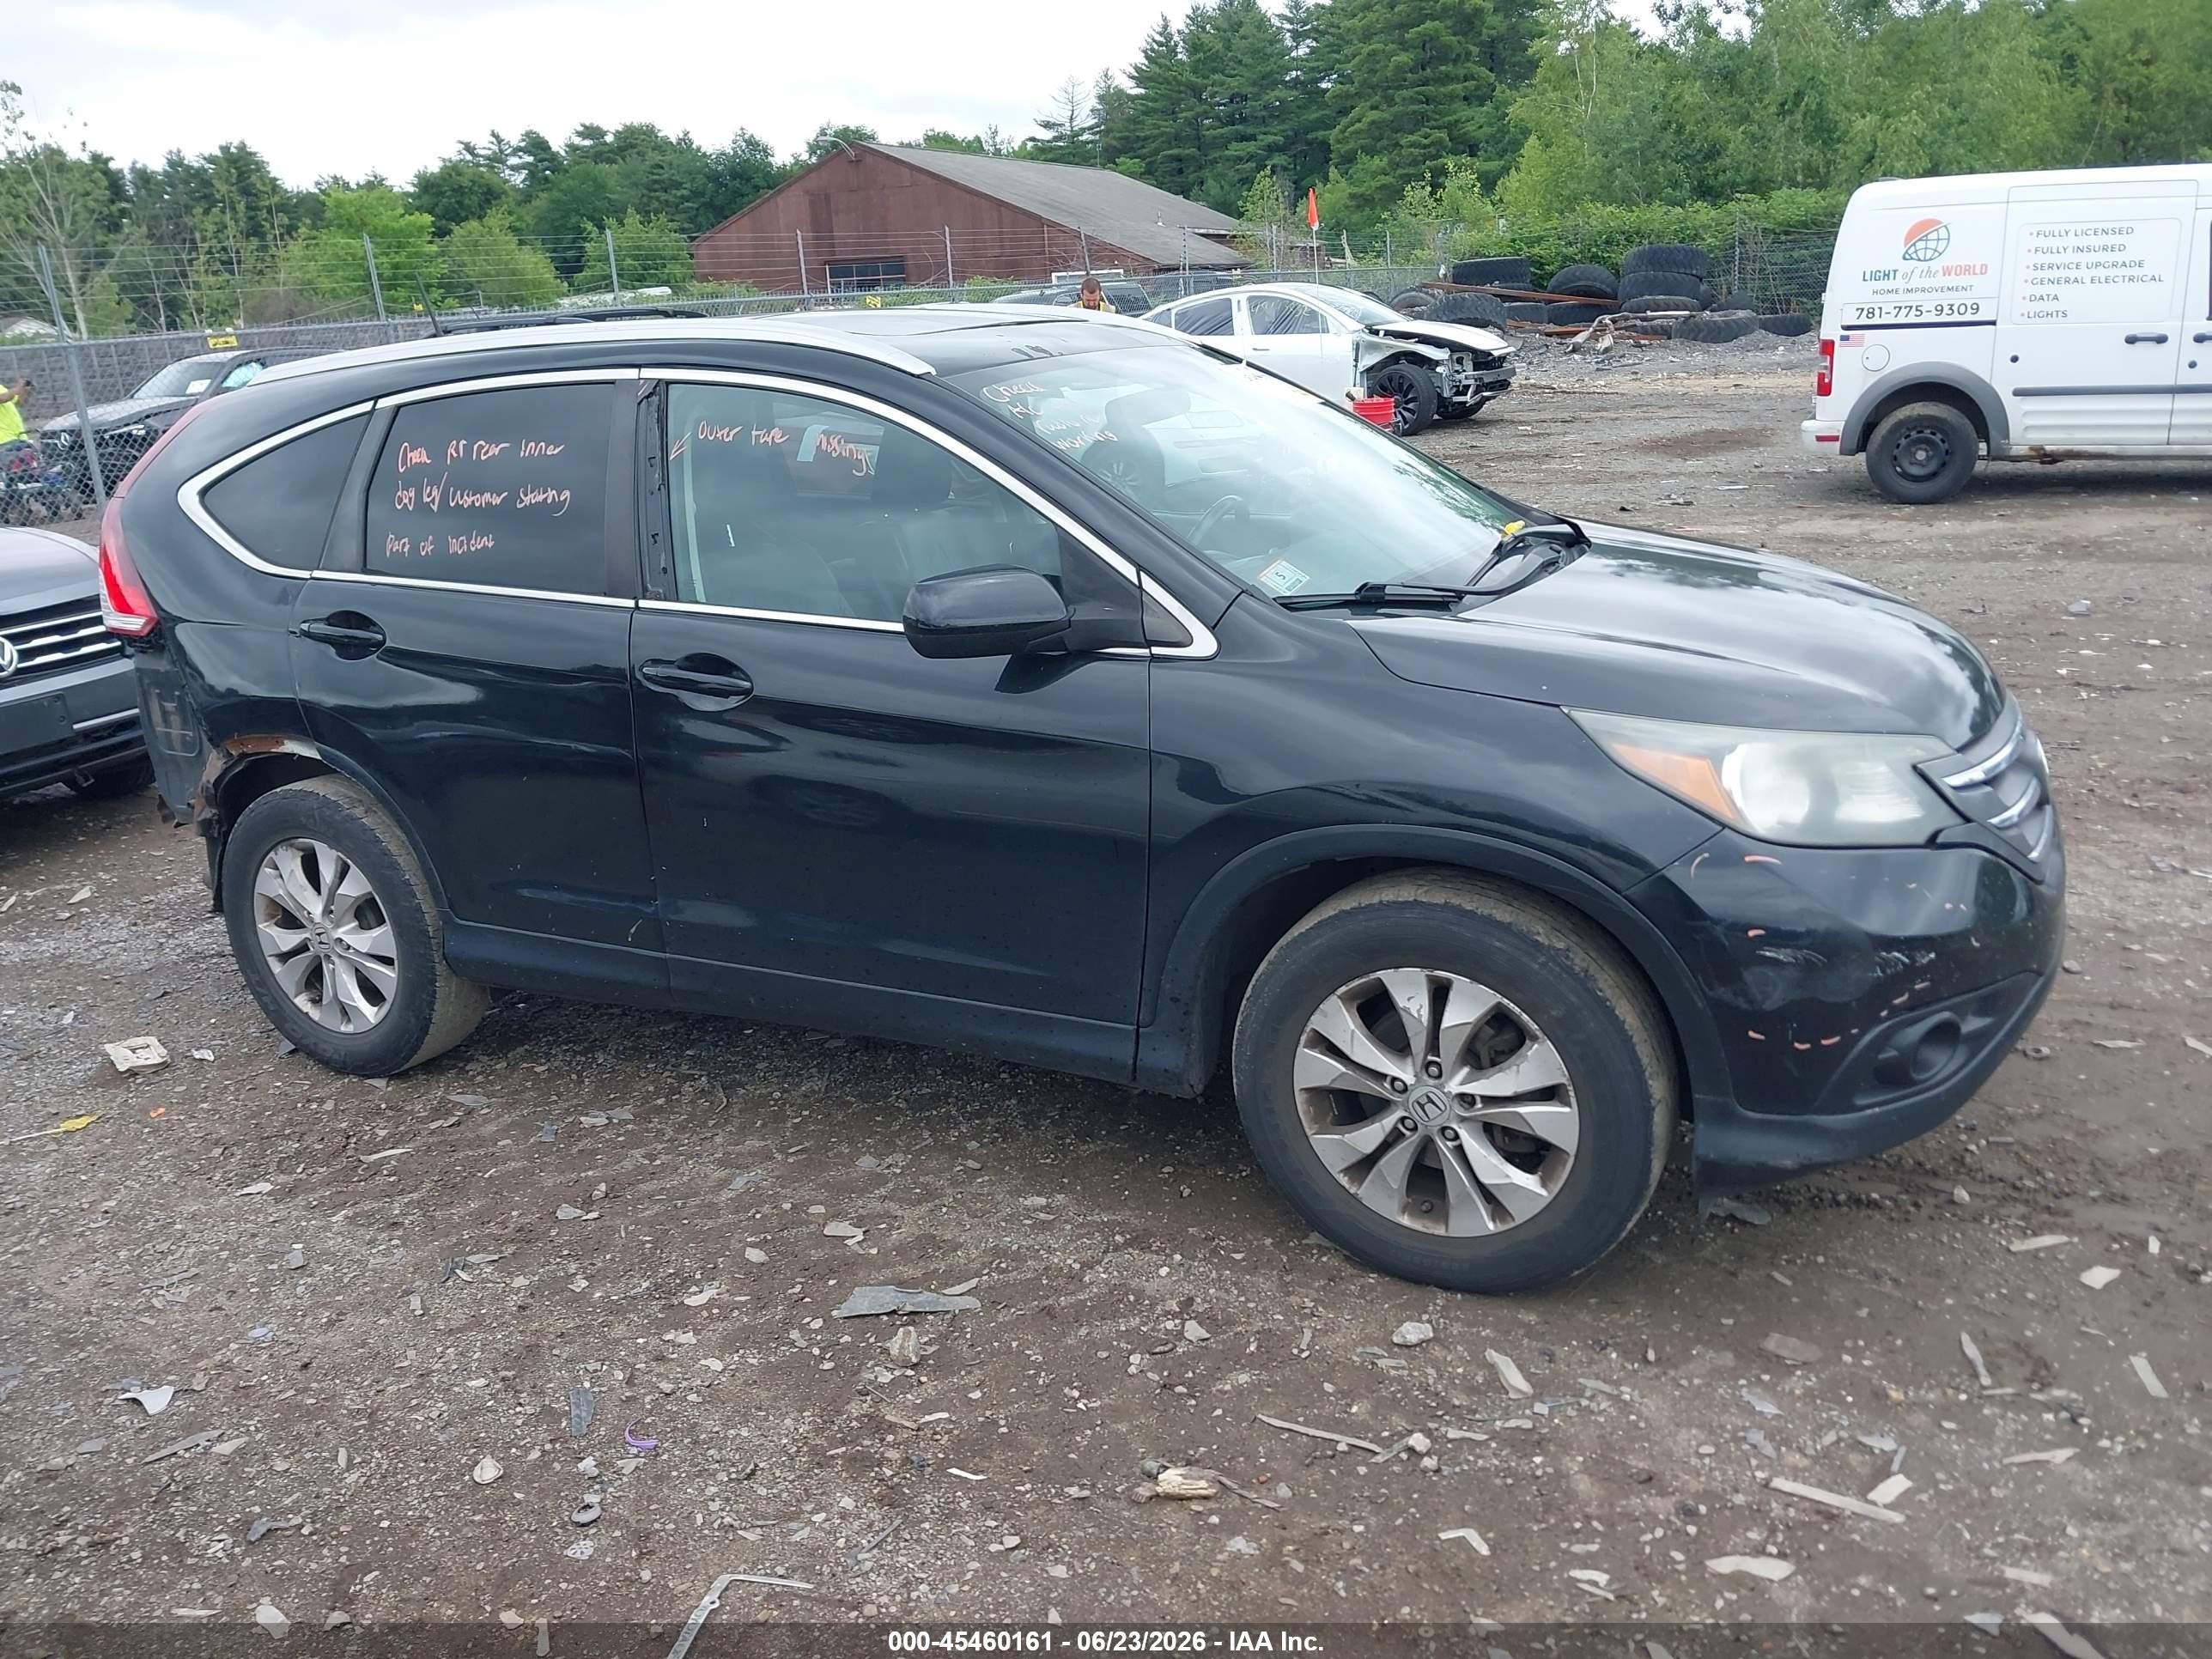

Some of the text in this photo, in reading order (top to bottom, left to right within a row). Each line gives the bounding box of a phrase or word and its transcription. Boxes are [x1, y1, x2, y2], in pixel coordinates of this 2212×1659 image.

[2036, 226, 2135, 238] FULLY LICENSED
[2034, 243, 2126, 255] FULLY INSURED
[2033, 259, 2146, 271] SERVICE UPGRADE
[1862, 264, 1989, 284] LIGHT of the WORLD
[2031, 274, 2165, 286] GENERAL ELECTRICAL
[1872, 284, 1974, 296] HOME IMPROVEMENT
[2029, 294, 2060, 302] DATA
[1855, 301, 1980, 320] 781-775-9309
[2027, 309, 2069, 319] LIGHTS
